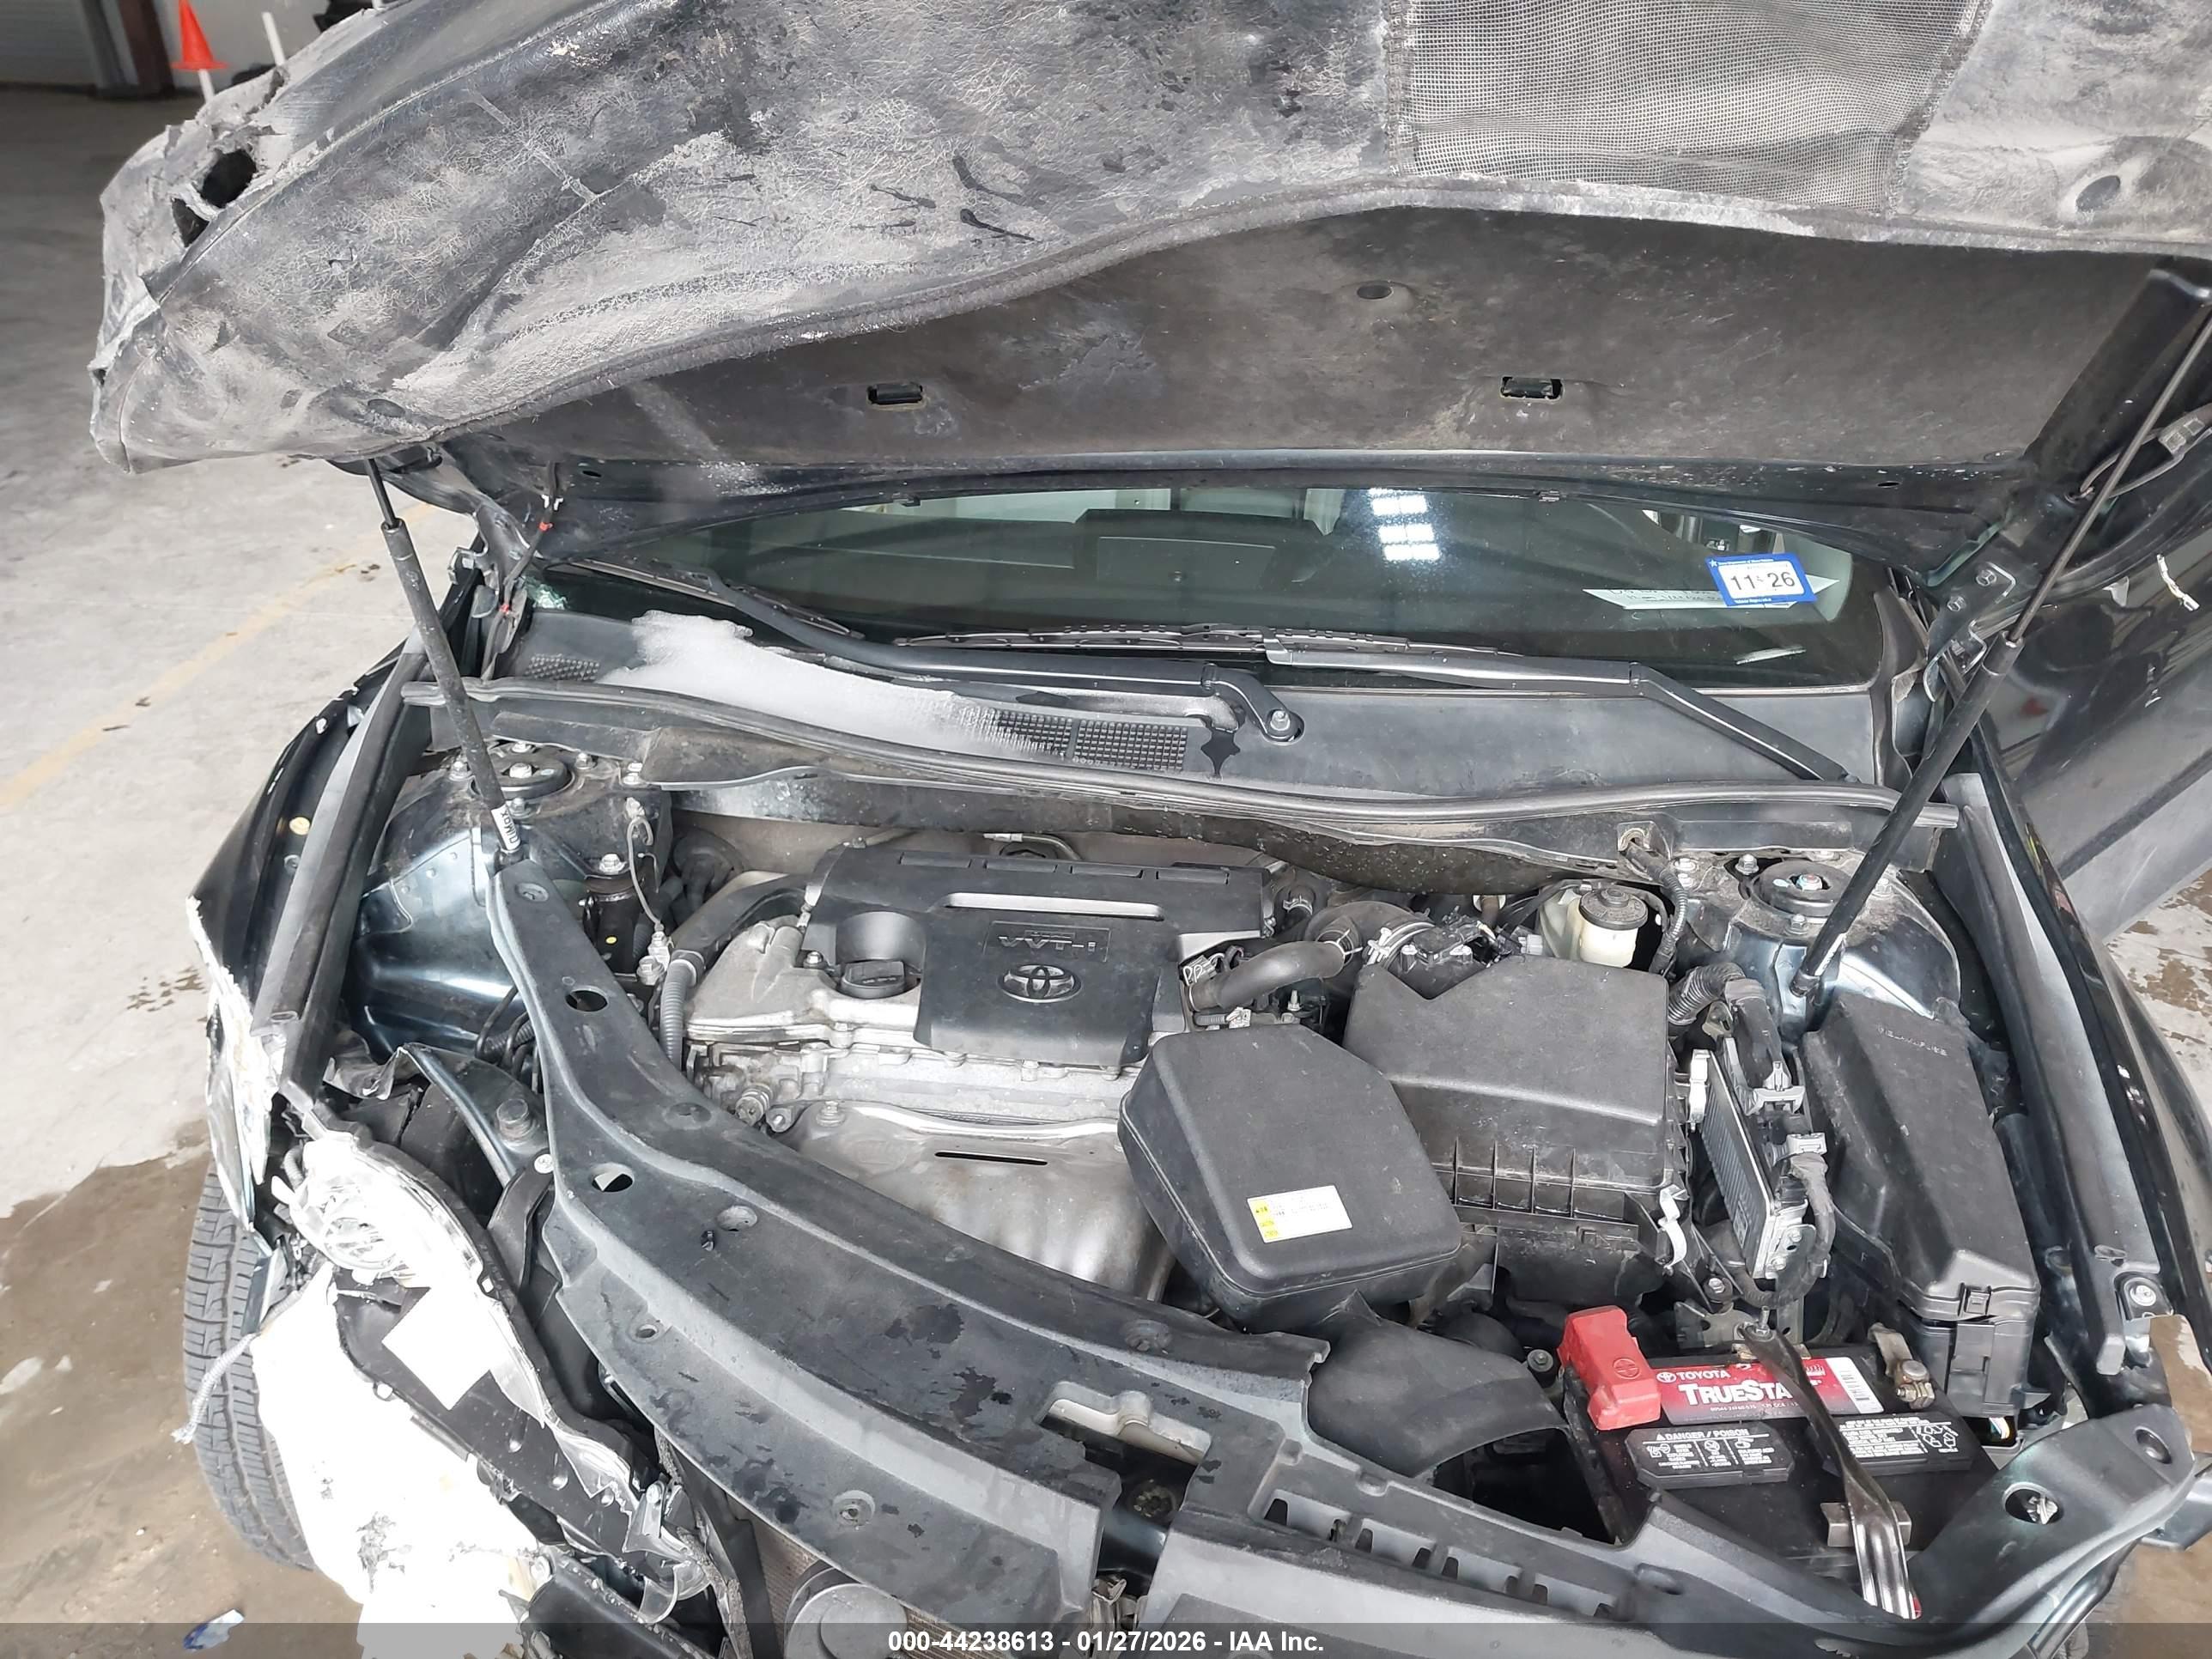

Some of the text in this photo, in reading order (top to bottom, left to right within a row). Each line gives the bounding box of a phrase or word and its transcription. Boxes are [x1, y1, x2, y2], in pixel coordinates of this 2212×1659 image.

[1730, 572, 1796, 591] 11 26
[1676, 1370, 1731, 1381] TOYOTA
[1678, 1379, 1796, 1406] TRUESTA
[1665, 1431, 1705, 1441] DANGER
[1714, 1429, 1750, 1437] POISON
